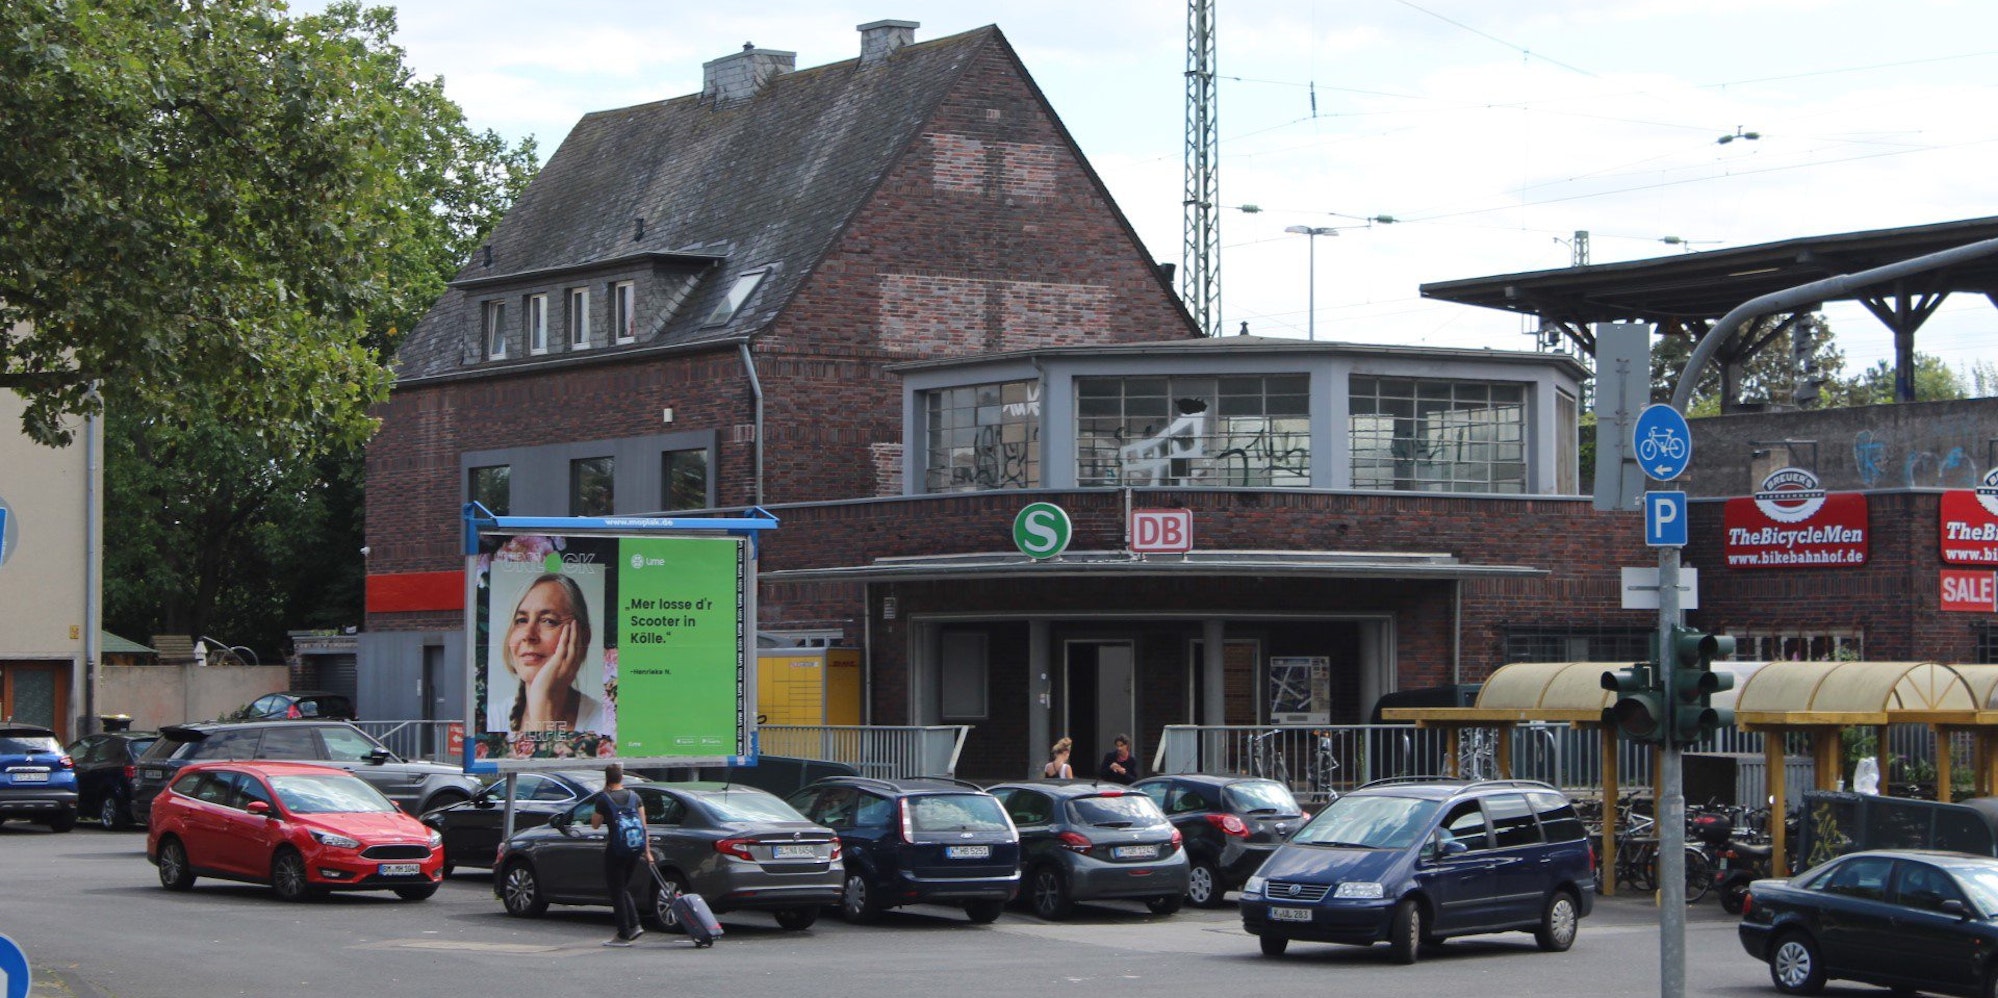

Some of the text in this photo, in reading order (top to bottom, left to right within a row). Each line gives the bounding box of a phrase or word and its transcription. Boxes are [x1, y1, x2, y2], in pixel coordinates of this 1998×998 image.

[1766, 473, 1814, 490] BREUER'S
[1655, 498, 1677, 538] P
[1024, 510, 1058, 552] S
[1139, 516, 1182, 545] DB
[1729, 525, 1863, 548] TheBicycleMen
[1728, 549, 1863, 565] www.bikebahnhof.de
[1943, 576, 1992, 603] SALE
[659, 598, 692, 610] losse
[631, 615, 696, 627] Scooter in
[523, 720, 567, 741] LIFE
[1294, 910, 1309, 919] 283
